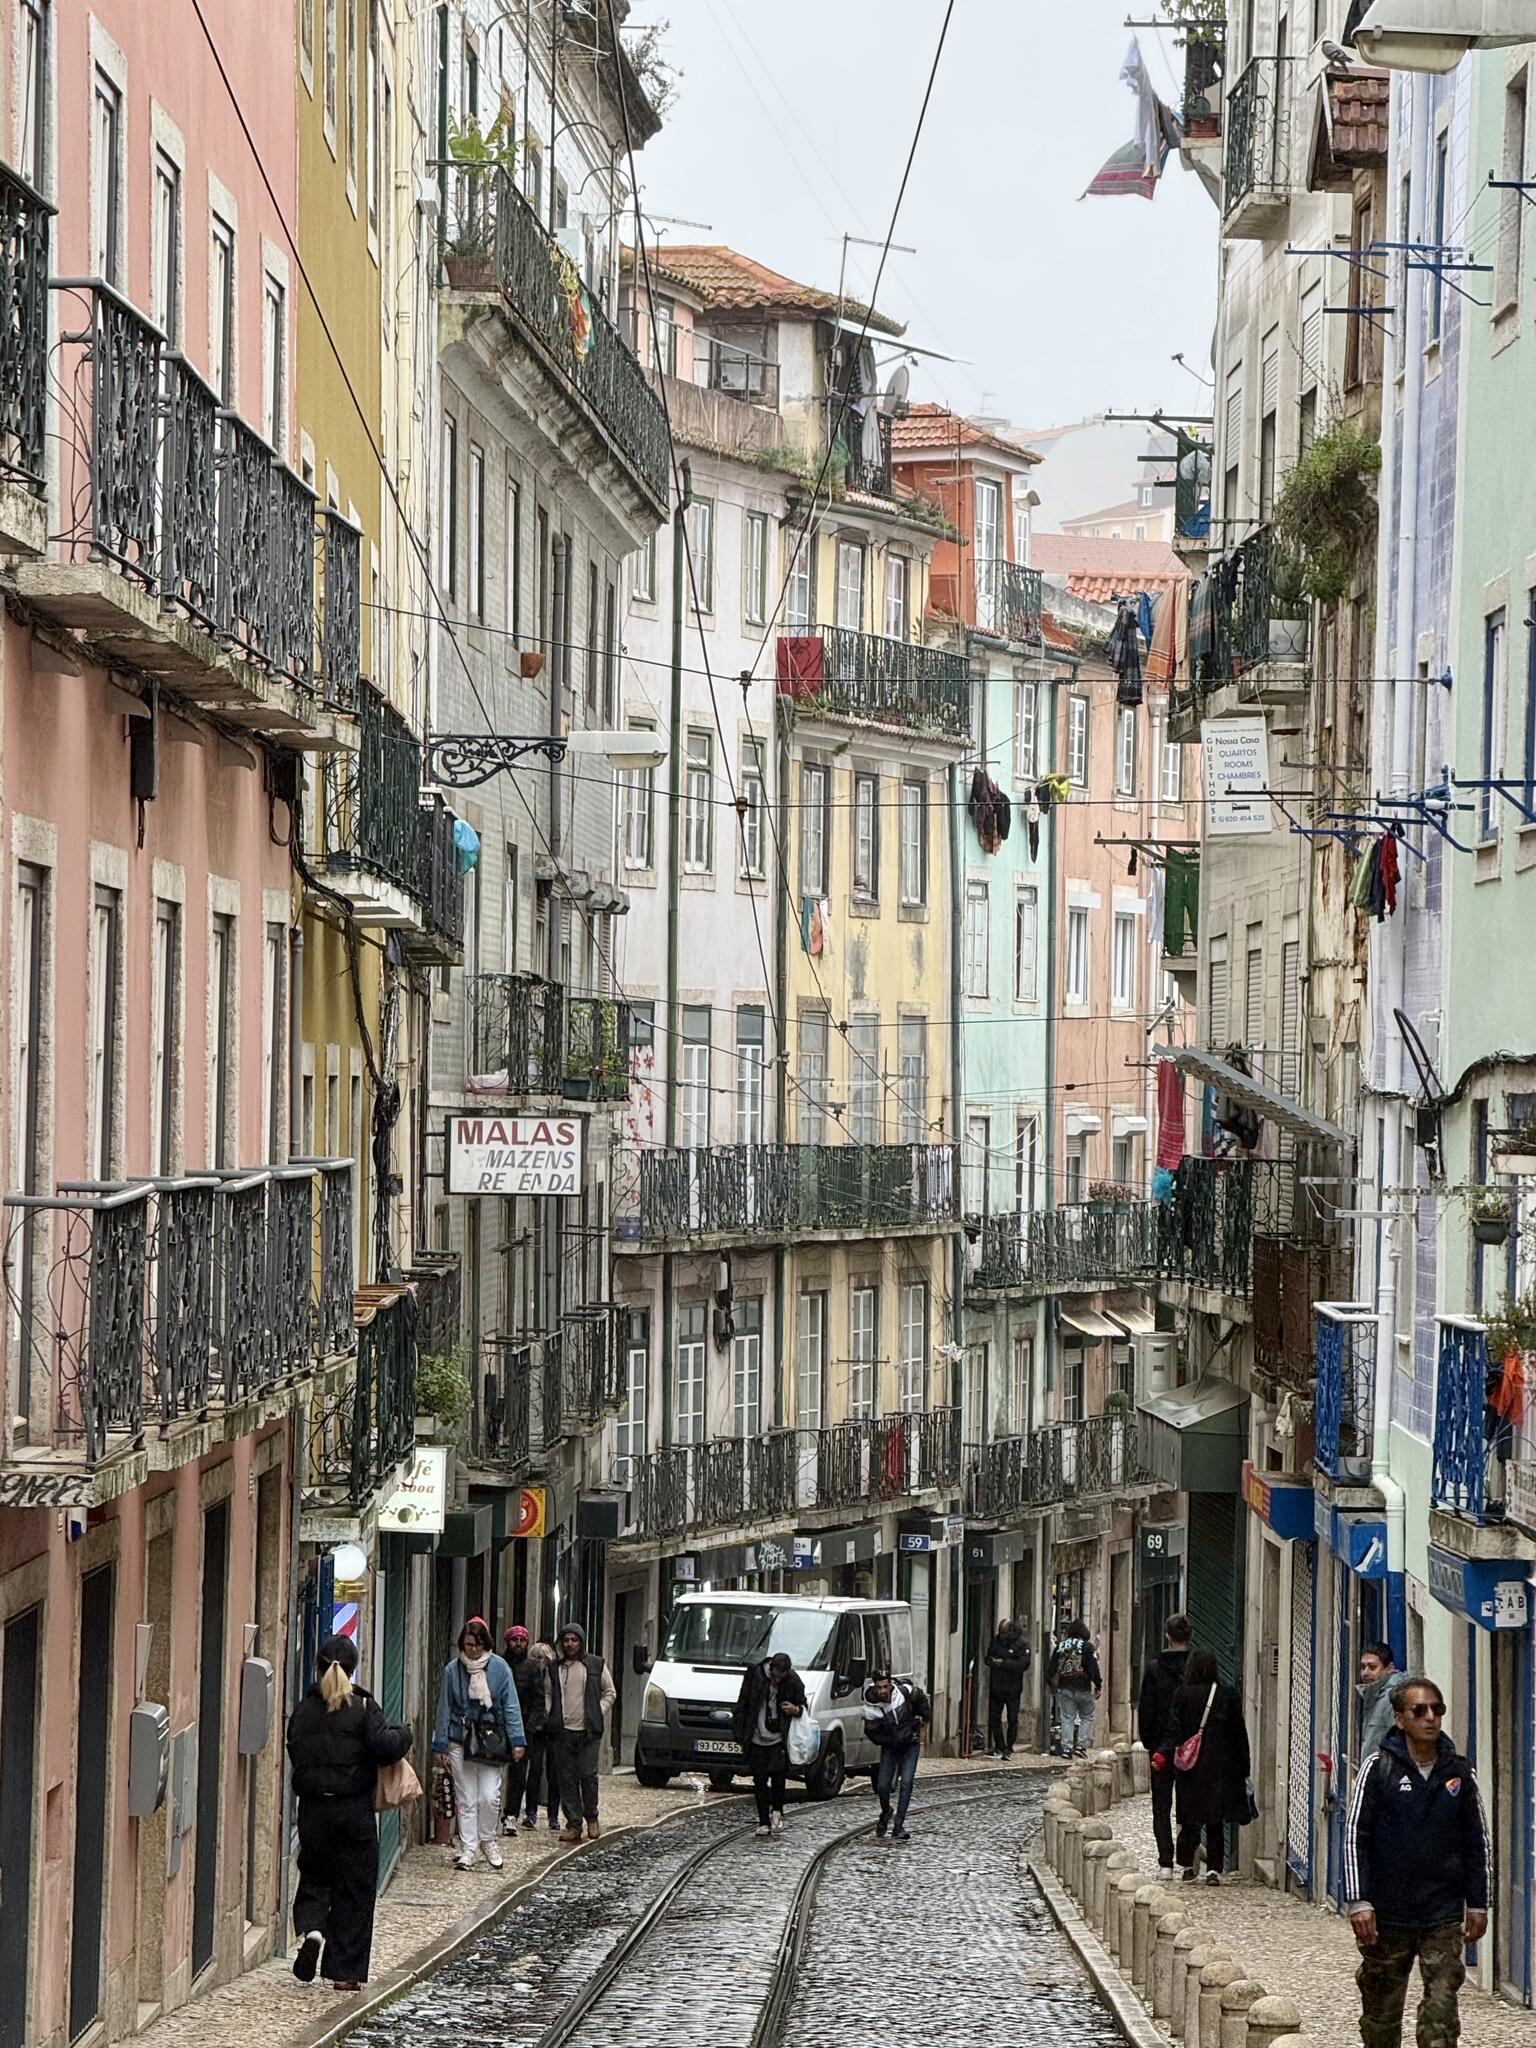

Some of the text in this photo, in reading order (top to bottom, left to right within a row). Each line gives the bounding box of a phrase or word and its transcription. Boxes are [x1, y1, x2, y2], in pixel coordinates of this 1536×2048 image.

[1240, 736, 1260, 744] Casa
[1219, 749, 1257, 758] QUARTOS
[1224, 760, 1253, 769] ROOMS
[1217, 771, 1261, 780] CHAMBRES
[457, 1120, 575, 1146] MALAS
[464, 1149, 576, 1169] MAZENS
[411, 1459, 433, 1480] fé
[907, 1537, 923, 1548] 59
[1147, 1534, 1163, 1549] 69
[972, 1548, 984, 1558] 61
[678, 1562, 693, 1576] 51
[1399, 1784, 1412, 1792] AG
